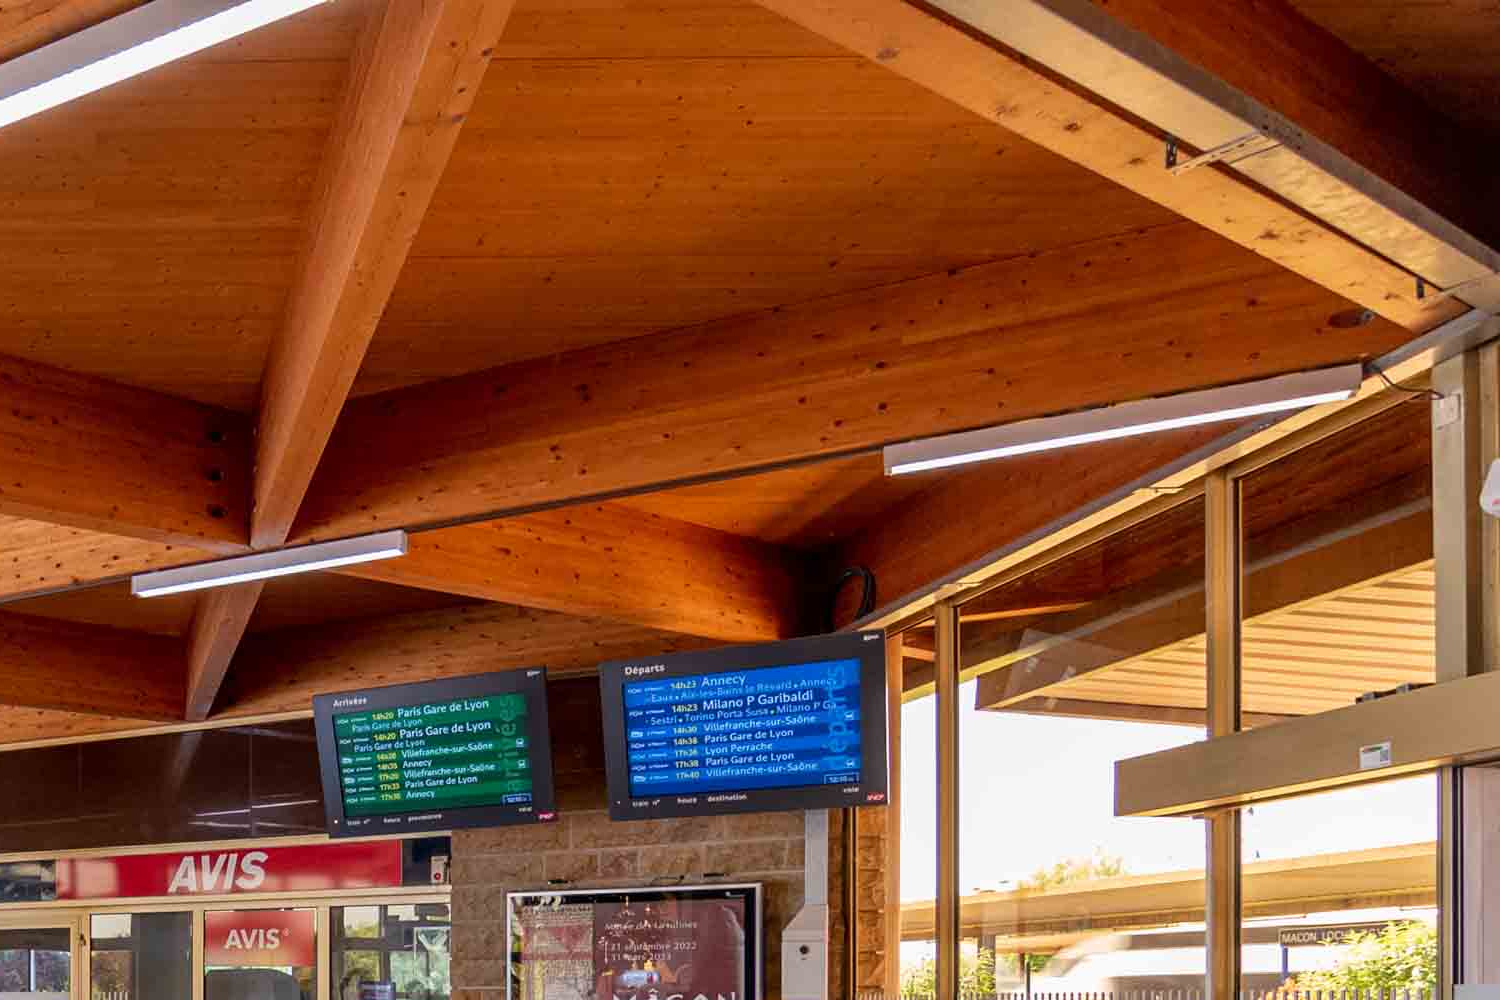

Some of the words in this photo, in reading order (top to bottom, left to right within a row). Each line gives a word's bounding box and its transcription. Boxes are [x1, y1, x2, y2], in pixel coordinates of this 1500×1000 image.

[624, 664, 666, 676] Départs
[701, 674, 747, 688] Annecy
[397, 706, 421, 719] Paris
[423, 704, 447, 715] Gare
[449, 701, 462, 712] de
[463, 699, 489, 713] Lyon
[672, 703, 698, 713] 14h23
[703, 698, 743, 711] Milano
[747, 695, 756, 706] P
[757, 690, 813, 705] Garibaldi
[776, 703, 811, 714] Milano
[352, 723, 371, 733] Paris
[372, 721, 390, 731] Gare
[392, 719, 402, 729] de
[403, 717, 422, 730] Lyon
[399, 727, 424, 740] Paris
[425, 725, 449, 736] Gare
[451, 723, 464, 733] de
[465, 720, 492, 734] Lyon
[703, 715, 816, 733] Villefranche-sur-Saône
[704, 734, 728, 745] Paris
[729, 732, 753, 742] Gare
[755, 730, 768, 740] de
[769, 728, 794, 740] Lyon
[354, 743, 373, 753] Paris
[374, 741, 393, 751] Gare
[394, 739, 404, 749] de
[405, 738, 425, 750] Lyon
[401, 742, 493, 759] Villefranche-sur-Saône
[705, 746, 728, 758] Lyon
[730, 742, 773, 754] Perrache
[402, 758, 432, 770] Annecy
[706, 756, 729, 767] Paris
[730, 755, 753, 764] Gare
[756, 753, 768, 763] de
[770, 751, 794, 764] Lyon
[403, 763, 496, 779] Villefranche-sur-Saône
[706, 762, 819, 778] Villefranche-sur-Saône
[404, 780, 424, 790] Paris
[425, 778, 445, 788] Gare
[445, 776, 457, 786] de
[457, 775, 478, 786] Lyon
[405, 789, 436, 800] Annecy
[707, 793, 748, 802] destination
[167, 851, 269, 894] AVIS
[224, 928, 282, 950] AVIS
[673, 941, 697, 951] 2022
